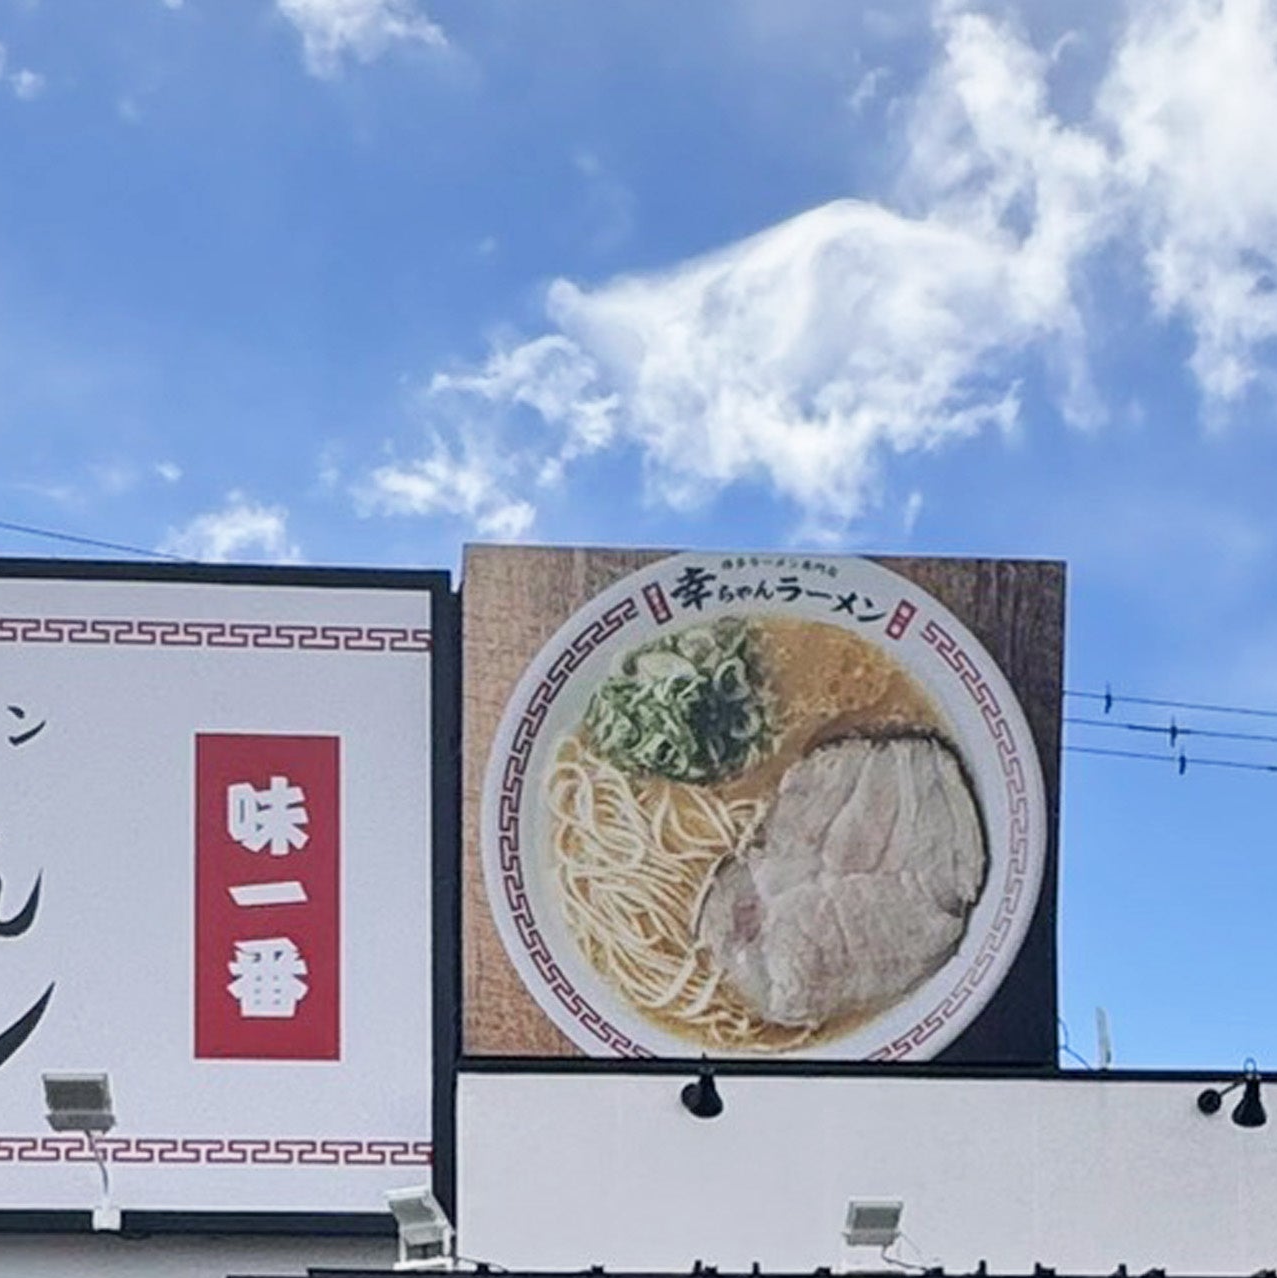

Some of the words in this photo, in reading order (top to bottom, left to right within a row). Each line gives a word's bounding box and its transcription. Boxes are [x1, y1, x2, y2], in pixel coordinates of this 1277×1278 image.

[671, 565, 887, 623] 幸ちゃんラーメン
[226, 775, 310, 1018] 味一番
